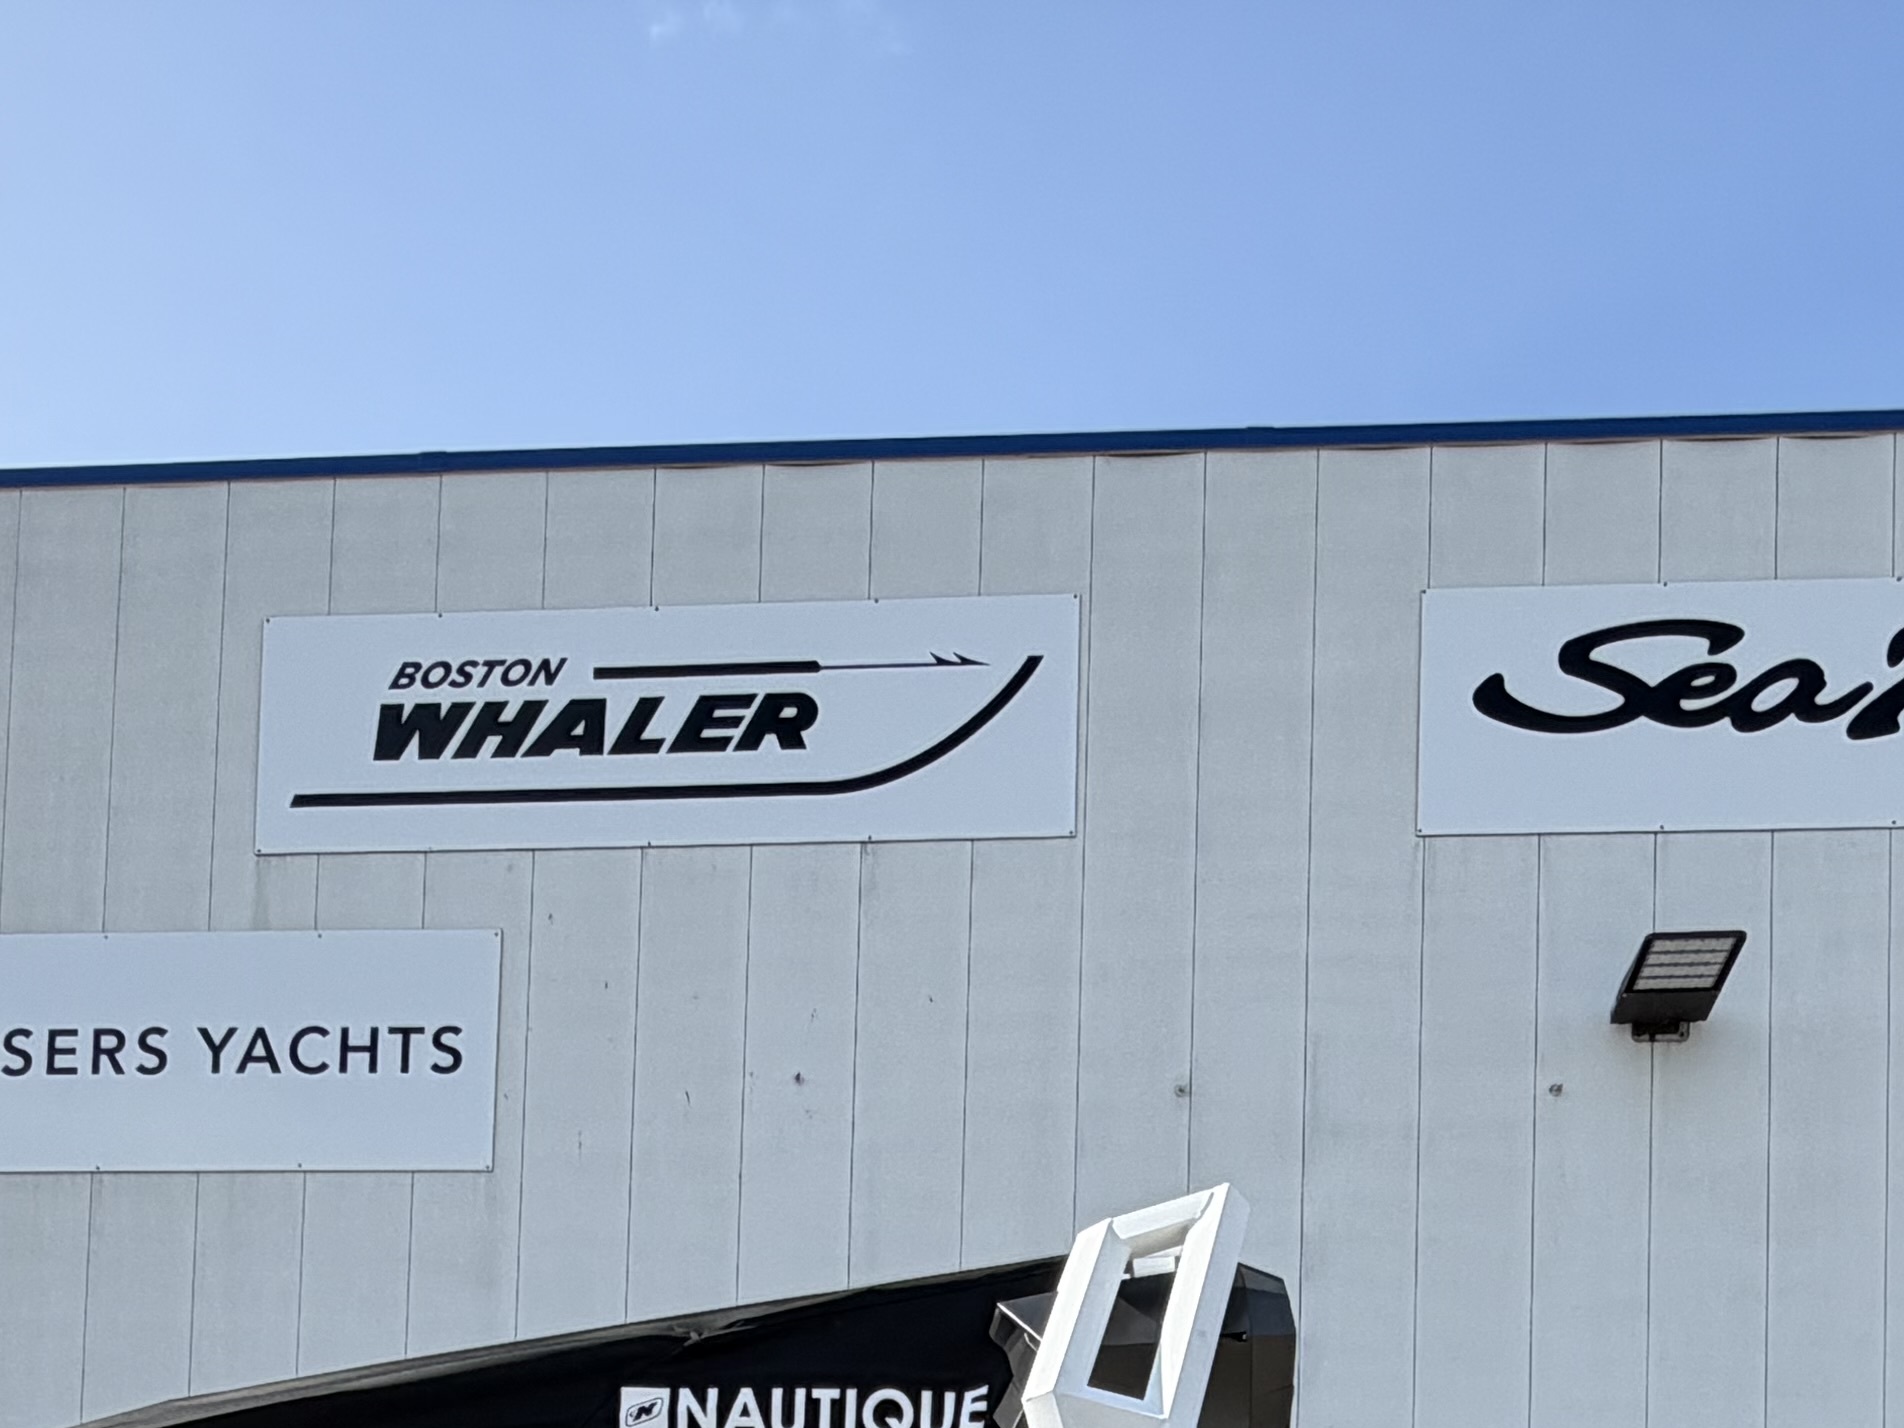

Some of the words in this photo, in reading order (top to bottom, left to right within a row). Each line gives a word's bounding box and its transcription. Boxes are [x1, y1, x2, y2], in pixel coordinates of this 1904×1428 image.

[388, 656, 568, 690] BOSTON
[1472, 618, 1874, 736] Sea
[372, 691, 819, 761] WHALER
[197, 1025, 463, 1075] YACHTS
